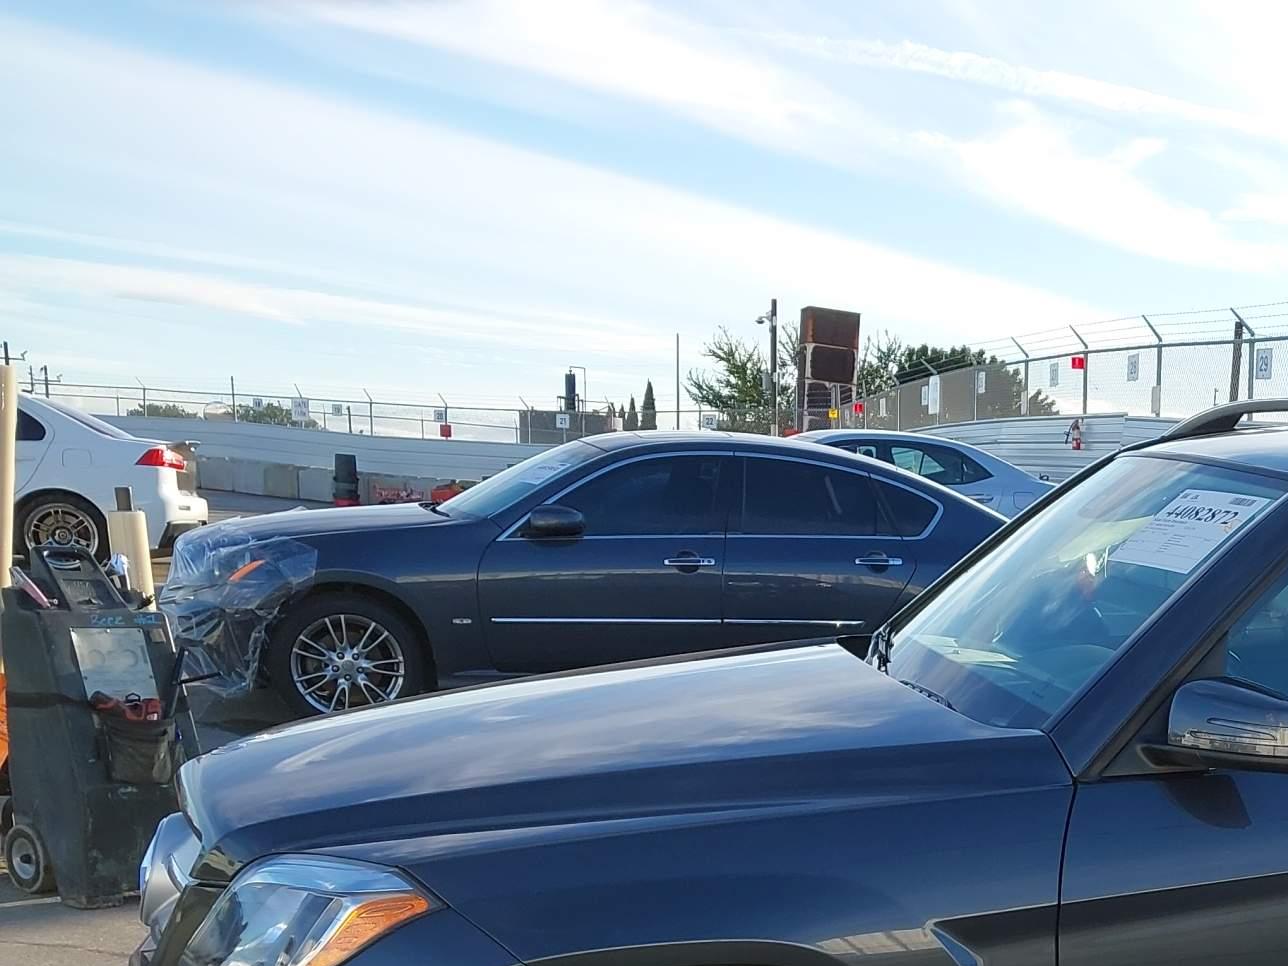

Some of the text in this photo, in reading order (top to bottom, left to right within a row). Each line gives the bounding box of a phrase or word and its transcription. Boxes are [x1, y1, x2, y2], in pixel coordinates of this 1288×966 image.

[1259, 355, 1269, 372] 29
[559, 417, 567, 425] 21
[705, 417, 714, 426] 22
[1166, 504, 1239, 525] 44082872
